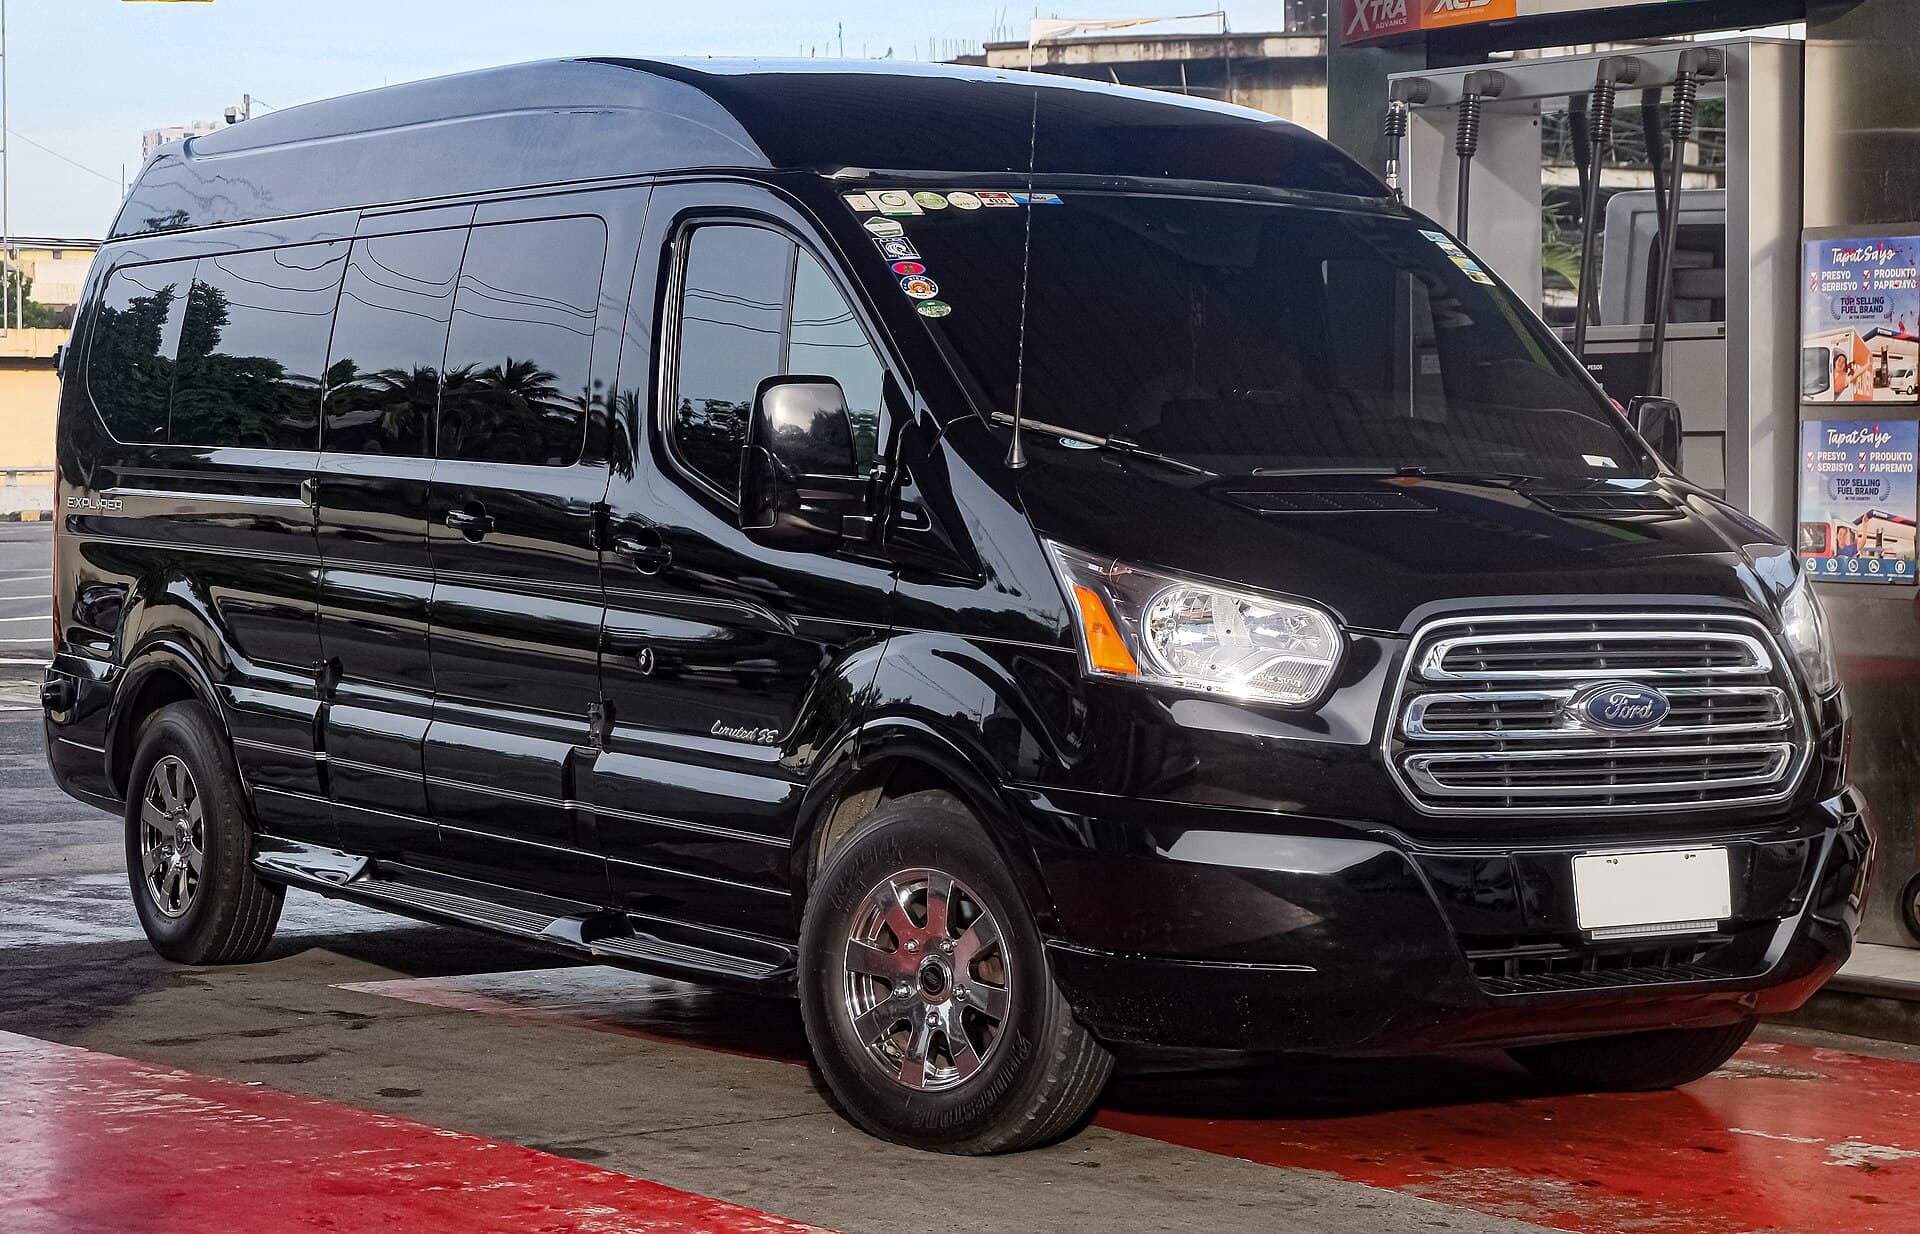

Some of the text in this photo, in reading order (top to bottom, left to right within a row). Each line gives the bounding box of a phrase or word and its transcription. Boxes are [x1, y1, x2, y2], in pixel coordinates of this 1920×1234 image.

[1346, 0, 1407, 36] XTRA
[1375, 17, 1408, 30] ADVANCE
[1821, 268, 1917, 281] PRESYO PRODUKTO
[1821, 280, 1917, 292] SERBISYO PAPREMYO
[1841, 296, 1885, 306] TOP SELLING
[1841, 305, 1884, 314] FUEL BRAND
[1817, 452, 1913, 461] PRESYO PRODUKTO
[1817, 463, 1913, 473] SERBISYO PAPREMYO
[1836, 478, 1880, 487] TOP SELLING
[1837, 487, 1879, 496] FUEL BRAND
[1605, 693, 1653, 719] Ford
[710, 719, 779, 743] Limited SE
